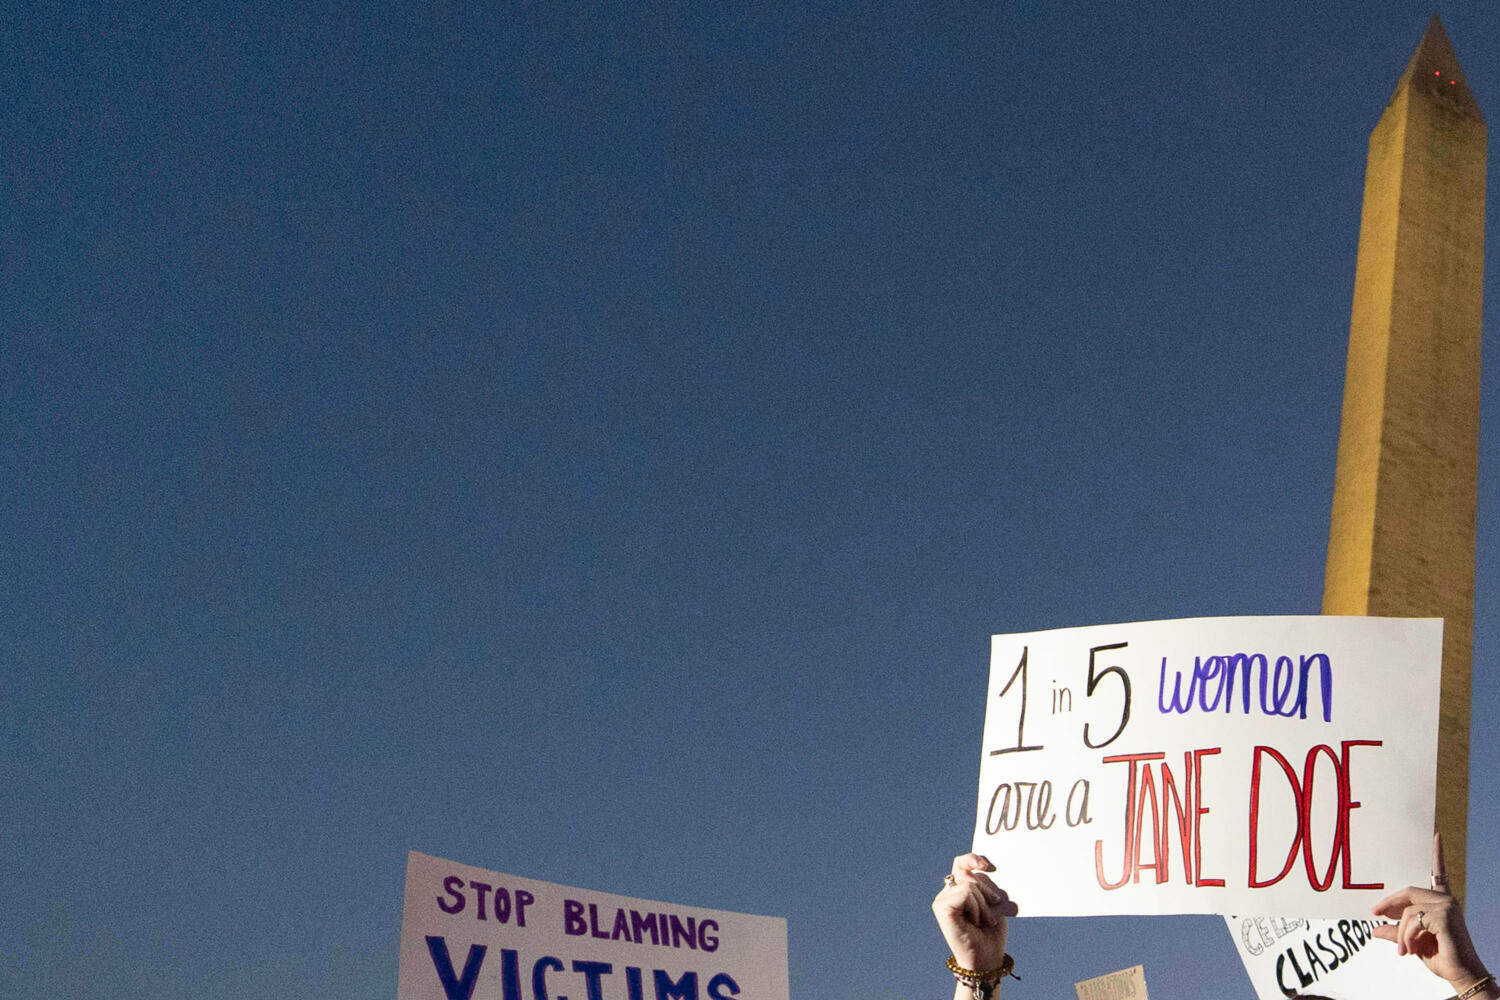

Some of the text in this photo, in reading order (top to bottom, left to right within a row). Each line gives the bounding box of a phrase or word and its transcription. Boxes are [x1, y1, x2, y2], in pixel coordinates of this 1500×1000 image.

[990, 641, 1333, 756] 1 in 5 women
[985, 740, 1385, 893] are a JANE DOE
[436, 875, 720, 952] STOP BLAMING
